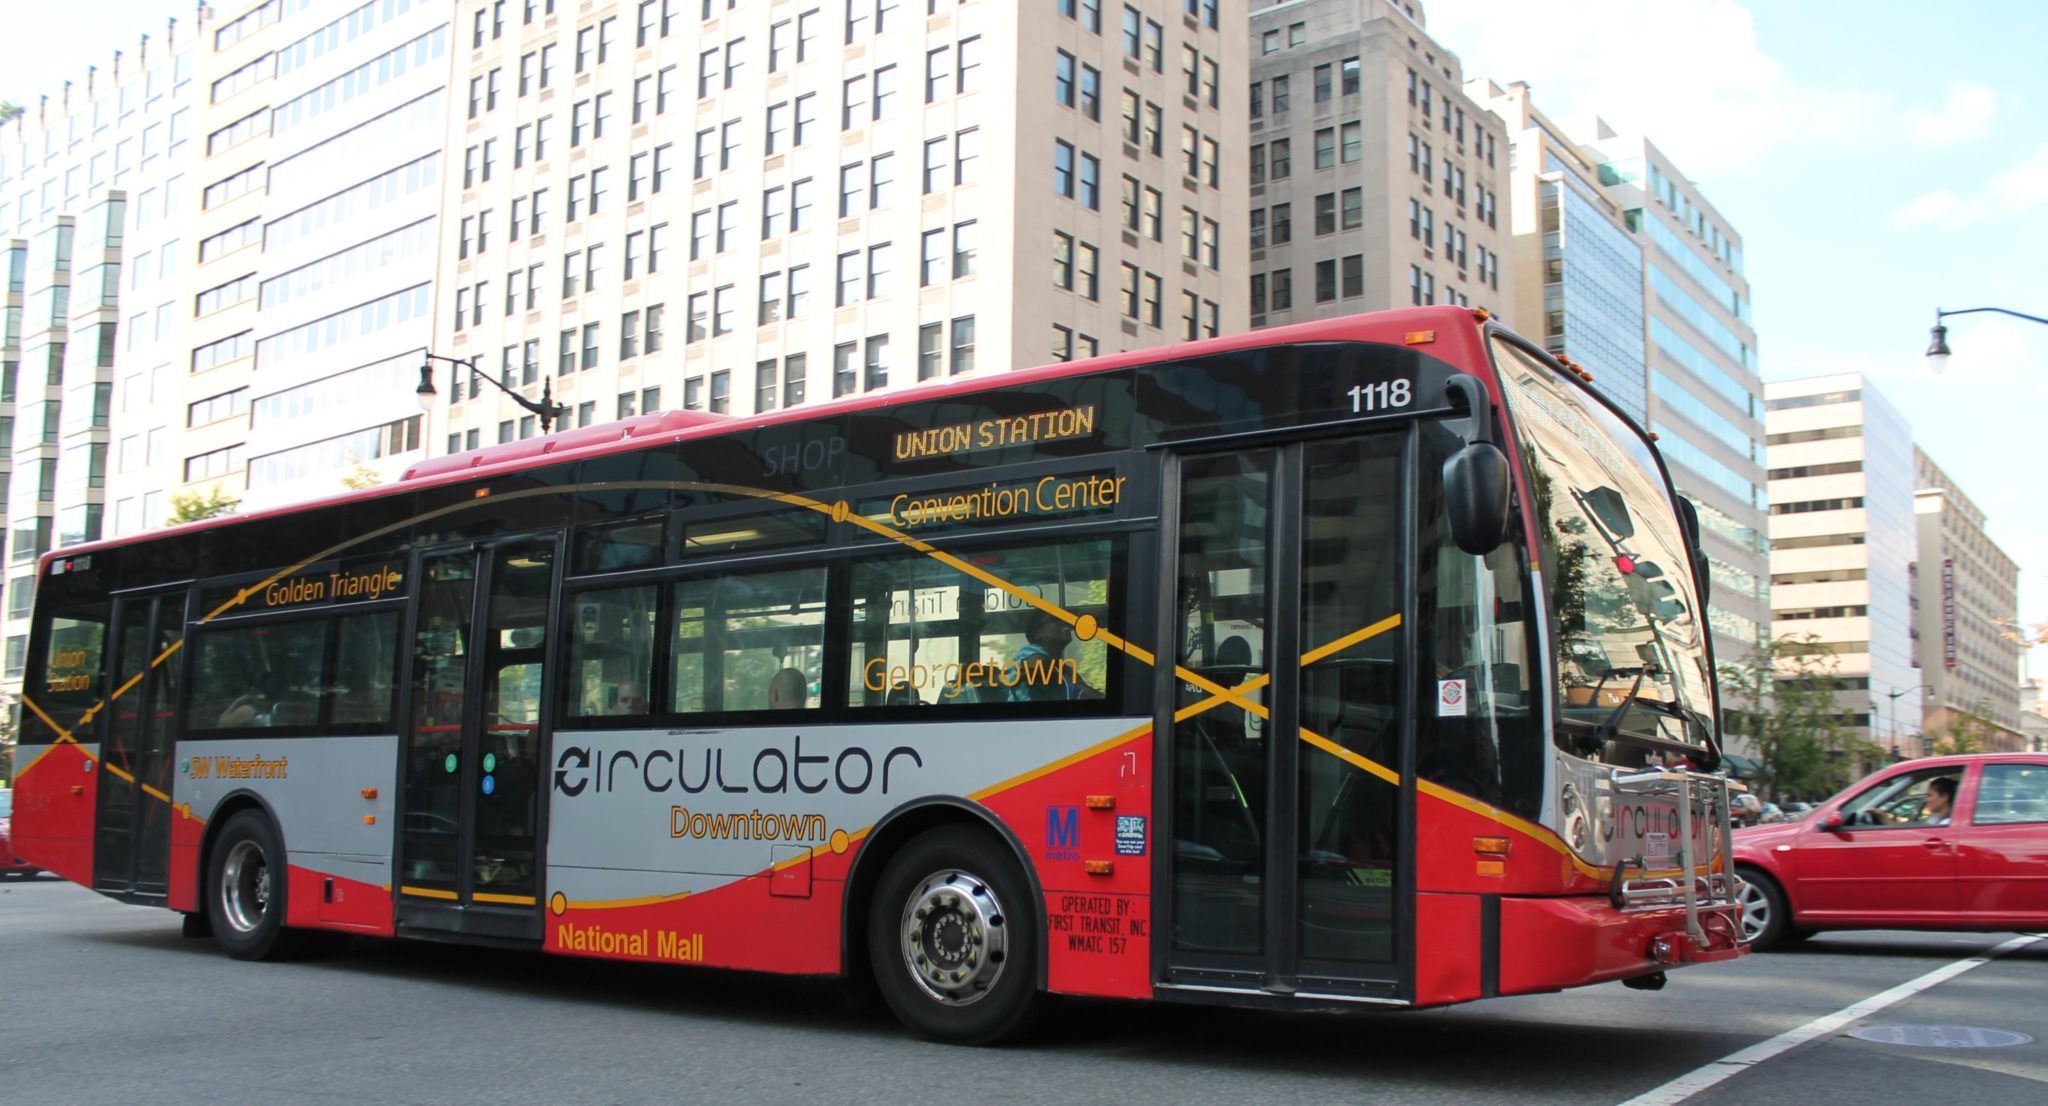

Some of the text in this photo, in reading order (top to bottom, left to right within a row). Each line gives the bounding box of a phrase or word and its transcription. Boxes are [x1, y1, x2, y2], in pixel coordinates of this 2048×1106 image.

[1348, 378, 1412, 413] 1118
[896, 406, 1094, 459] UNION STATION
[763, 436, 846, 479] SHOP
[890, 475, 1126, 528] Convention Center
[266, 566, 398, 606] Golden Triangle
[864, 655, 1079, 698] Georgetown
[214, 753, 288, 779] Waterfront
[670, 805, 826, 842] Downtown
[1049, 807, 1078, 848] M
[1045, 850, 1080, 861] metro
[1048, 914, 1074, 931] FIRST
[1062, 896, 1111, 915] OPERATED
[557, 923, 704, 962] National Mall
[1068, 934, 1127, 955] WMATC 157
